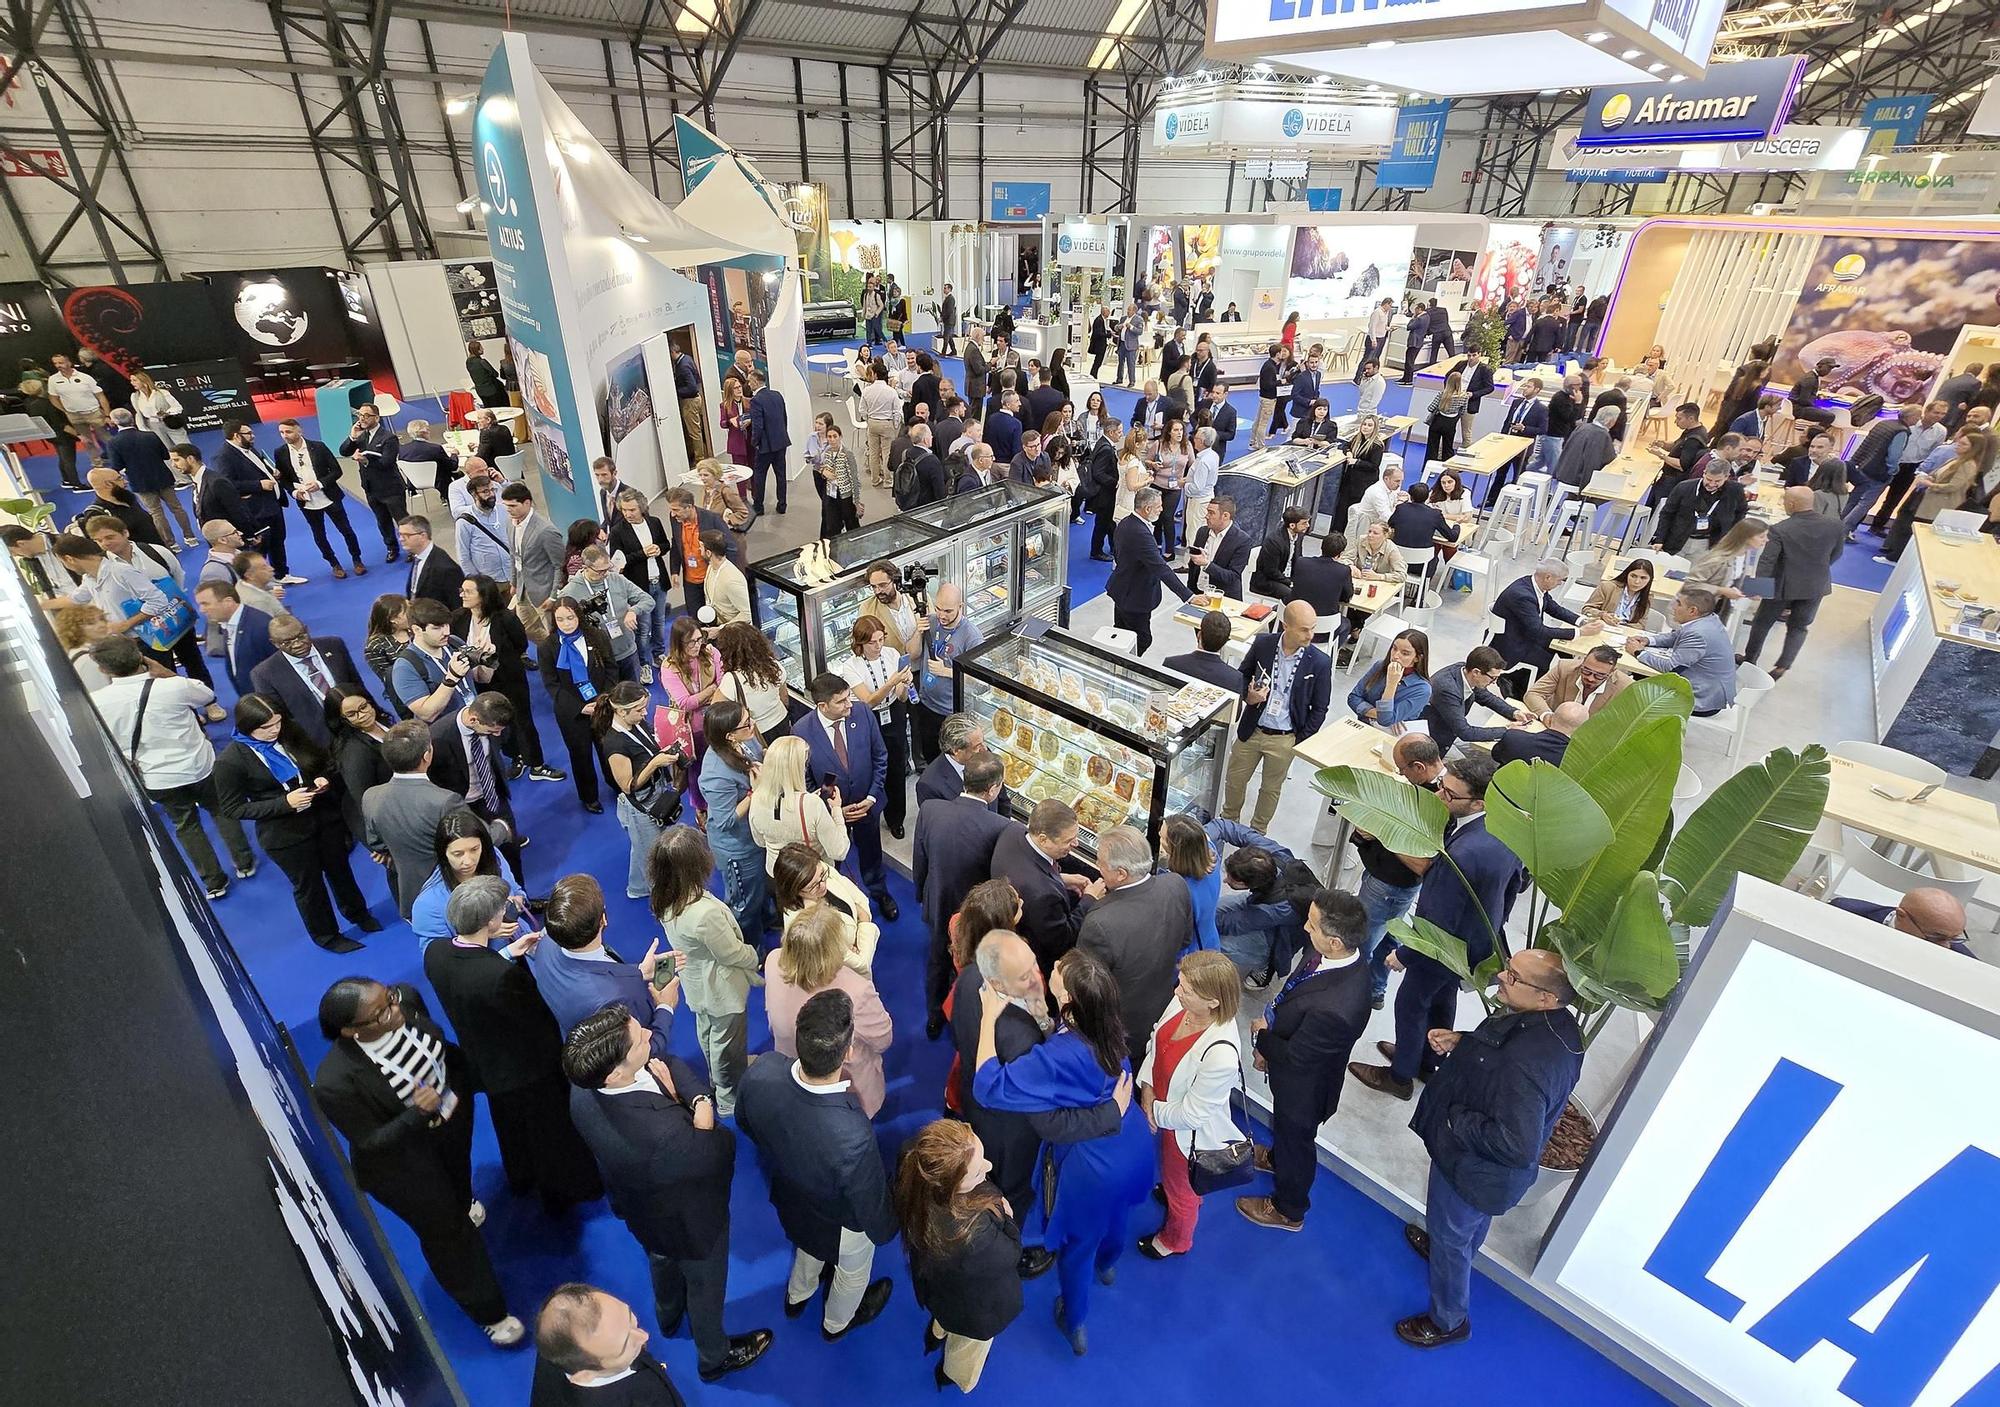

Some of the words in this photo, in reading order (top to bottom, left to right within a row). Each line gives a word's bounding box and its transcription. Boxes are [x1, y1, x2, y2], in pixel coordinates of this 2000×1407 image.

[29, 61, 46, 88] 28
[375, 83, 386, 105] 29
[1633, 93, 1758, 125] Aframar
[1873, 107, 1902, 120] HALL
[1904, 106, 1915, 119] 3
[1179, 117, 1209, 132] VIDELA
[1306, 118, 1351, 132] VIDELA
[1407, 121, 1429, 138] HALL
[1432, 120, 1439, 138] 1
[1403, 138, 1426, 155] HALL
[1427, 139, 1437, 155] 2
[498, 225, 525, 251] ALTIUS
[1073, 241, 1106, 252] VIDELA
[1814, 283, 1868, 296] AFRAMAR
[1643, 1057, 2000, 1407] LA
